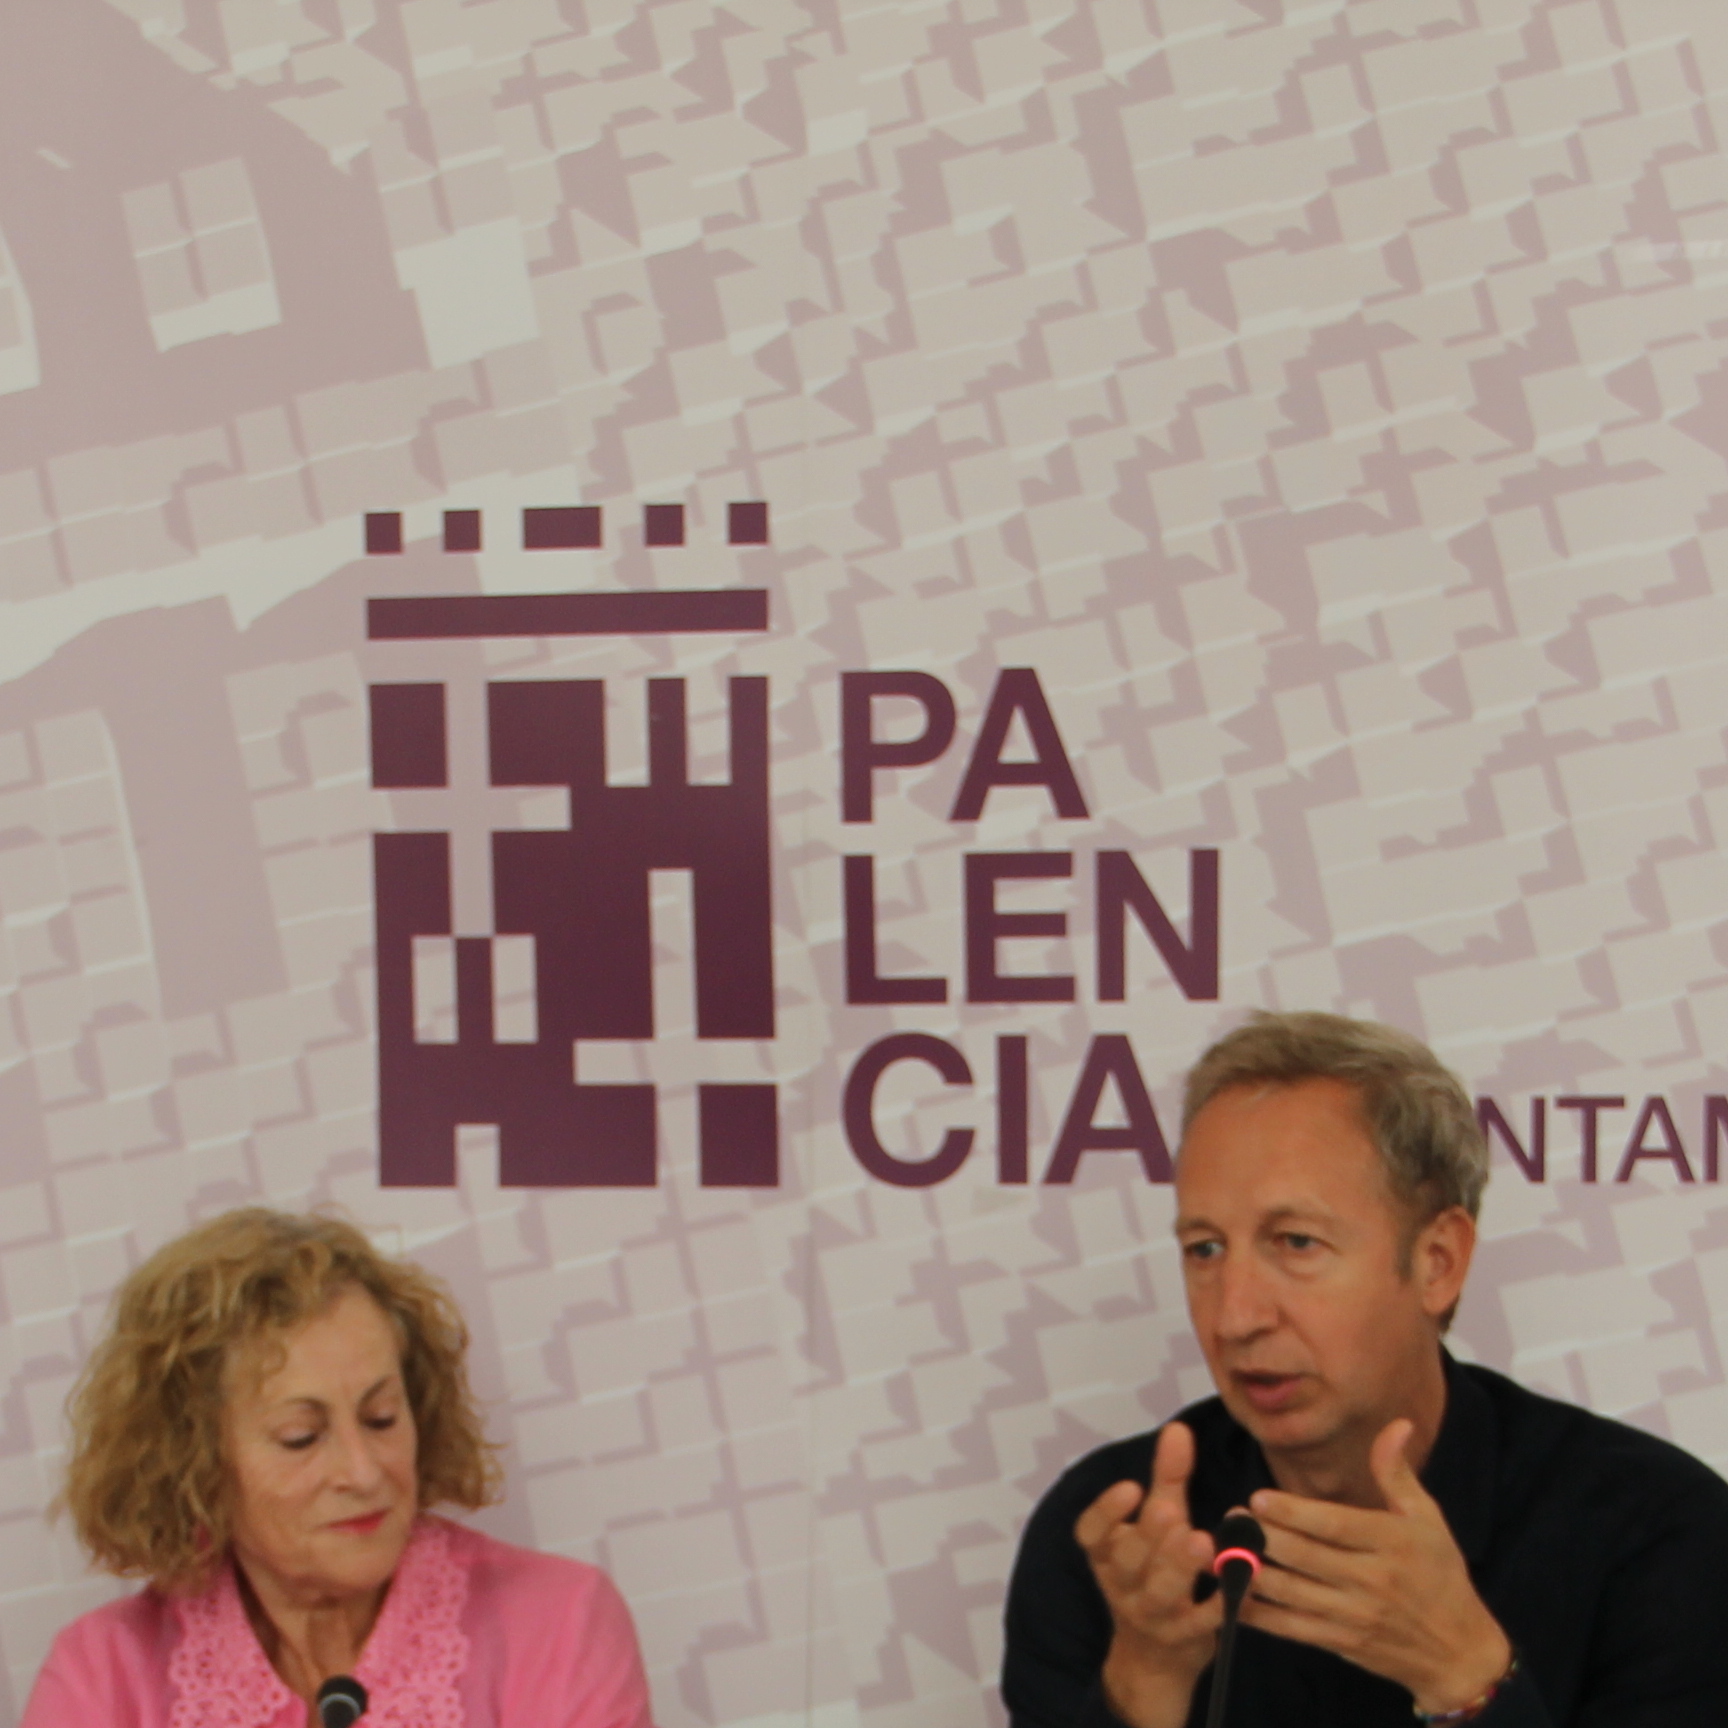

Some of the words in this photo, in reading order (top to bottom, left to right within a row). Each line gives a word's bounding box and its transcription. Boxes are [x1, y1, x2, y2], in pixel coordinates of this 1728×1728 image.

[840, 667, 1091, 824] PA
[841, 847, 1220, 1005] LEN
[842, 1030, 1176, 1188] CIA
